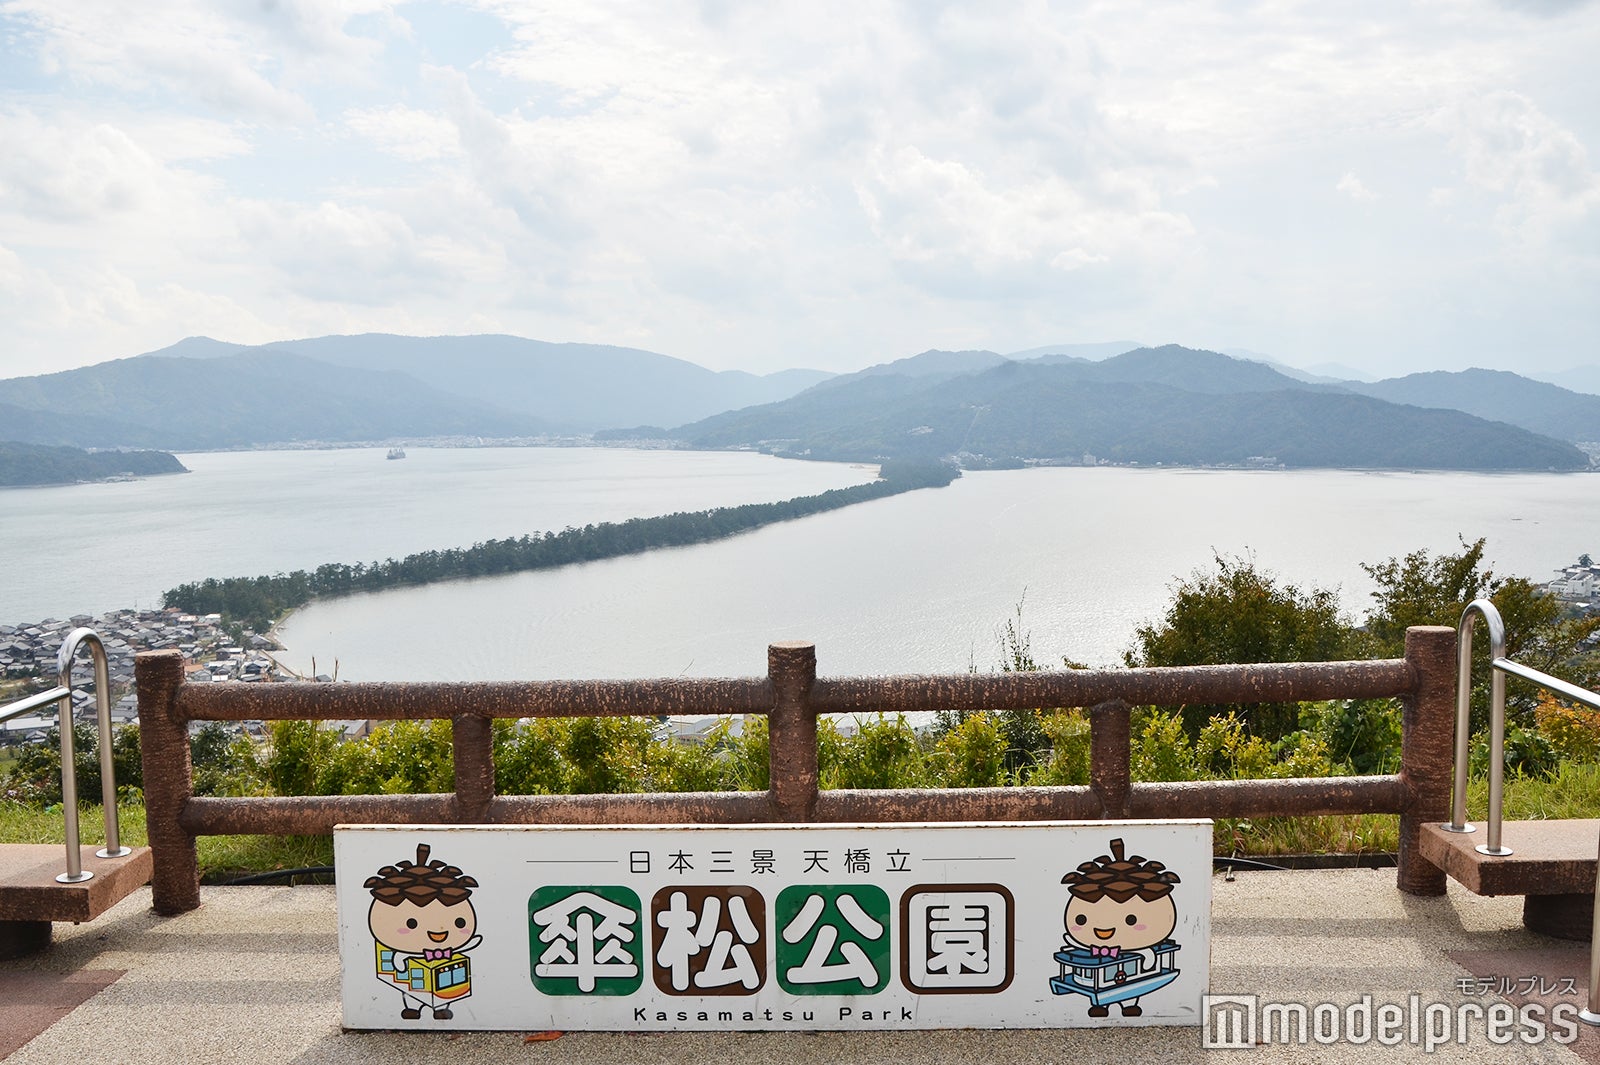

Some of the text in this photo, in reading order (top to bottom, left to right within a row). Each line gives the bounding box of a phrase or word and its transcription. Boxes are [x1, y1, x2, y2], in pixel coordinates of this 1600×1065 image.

[630, 848, 914, 875] 日本三景 天橋立
[532, 890, 1006, 994] 傘松公園
[634, 1007, 914, 1021] Kasamatsu Park
